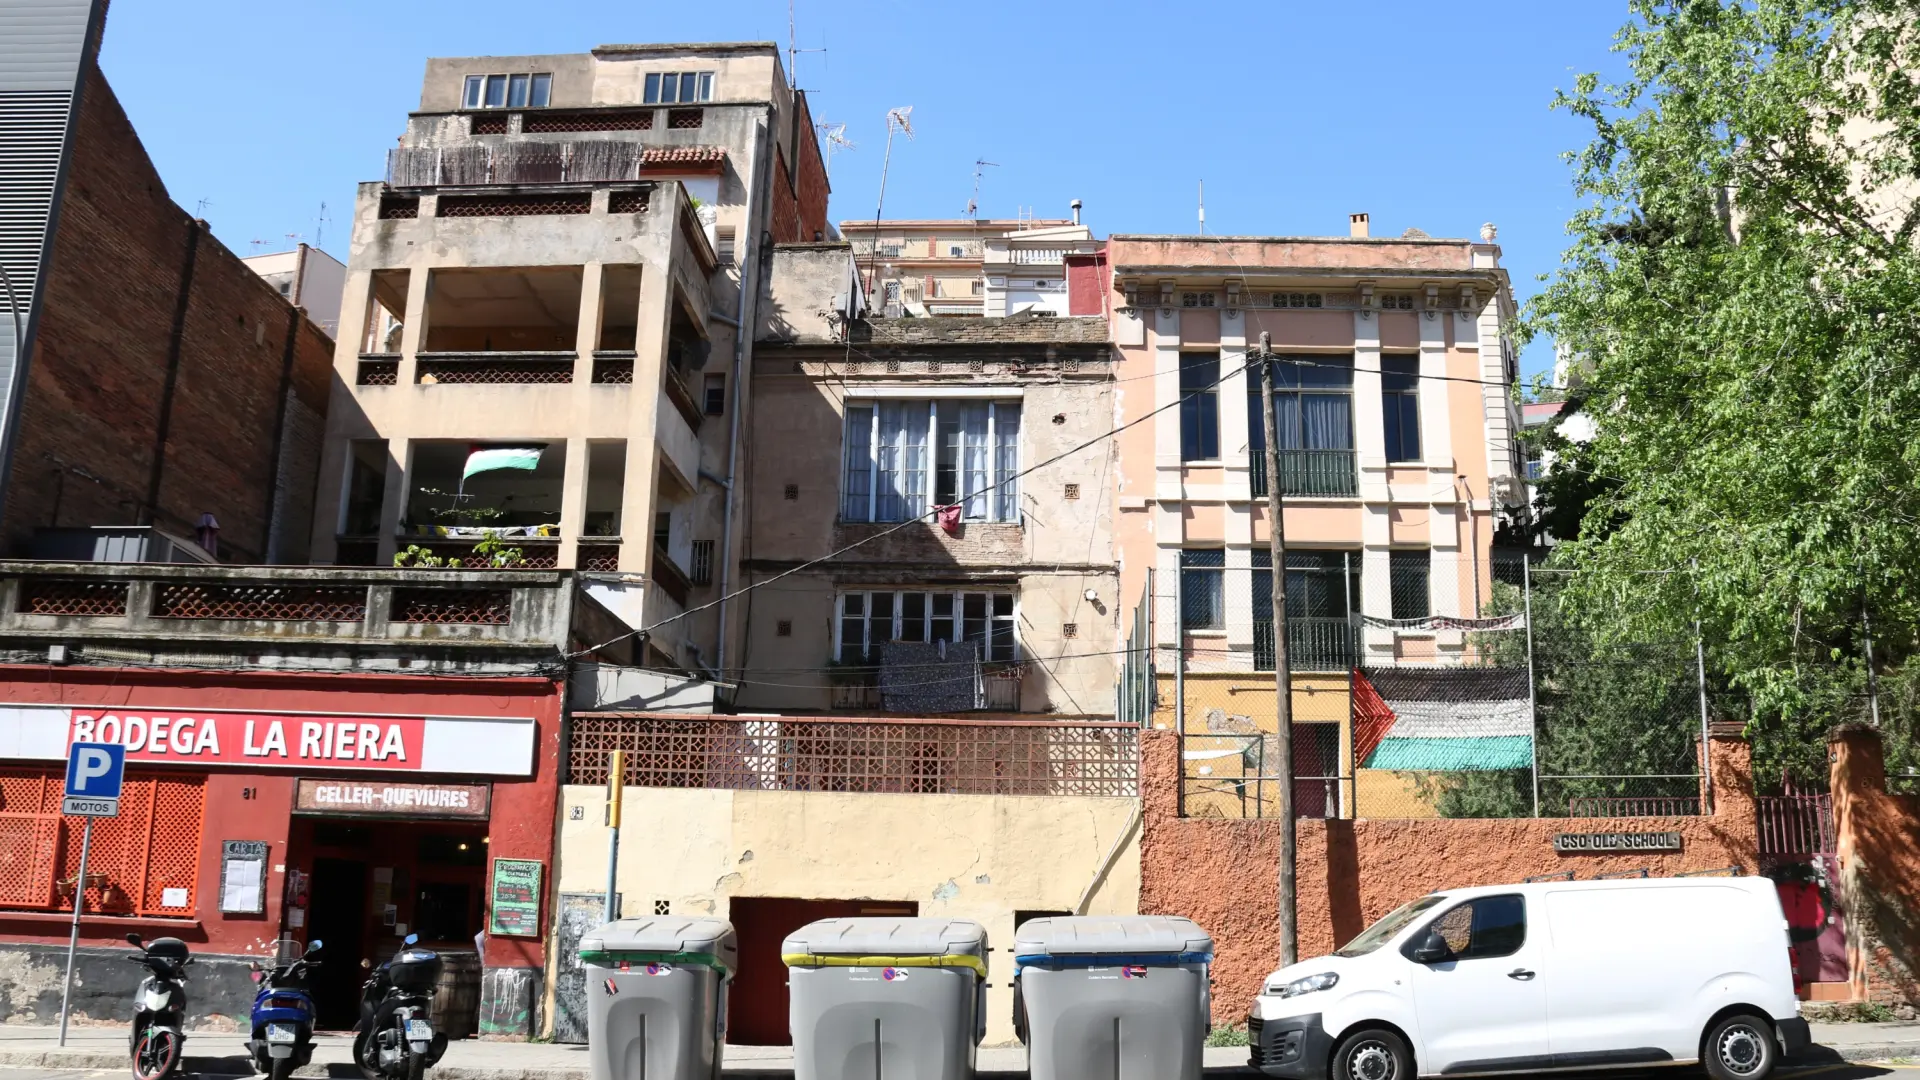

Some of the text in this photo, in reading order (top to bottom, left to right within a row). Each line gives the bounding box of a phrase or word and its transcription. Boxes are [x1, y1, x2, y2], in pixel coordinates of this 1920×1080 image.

[73, 715, 407, 761] BODEGA LA RIERA
[74, 748, 112, 790] P
[316, 786, 470, 808] CELLER-QUEVIURES
[71, 802, 109, 812] MOTOS
[229, 843, 262, 854] CARTA
[1561, 834, 1587, 848] CSO
[1624, 833, 1674, 848] SCHOOL
